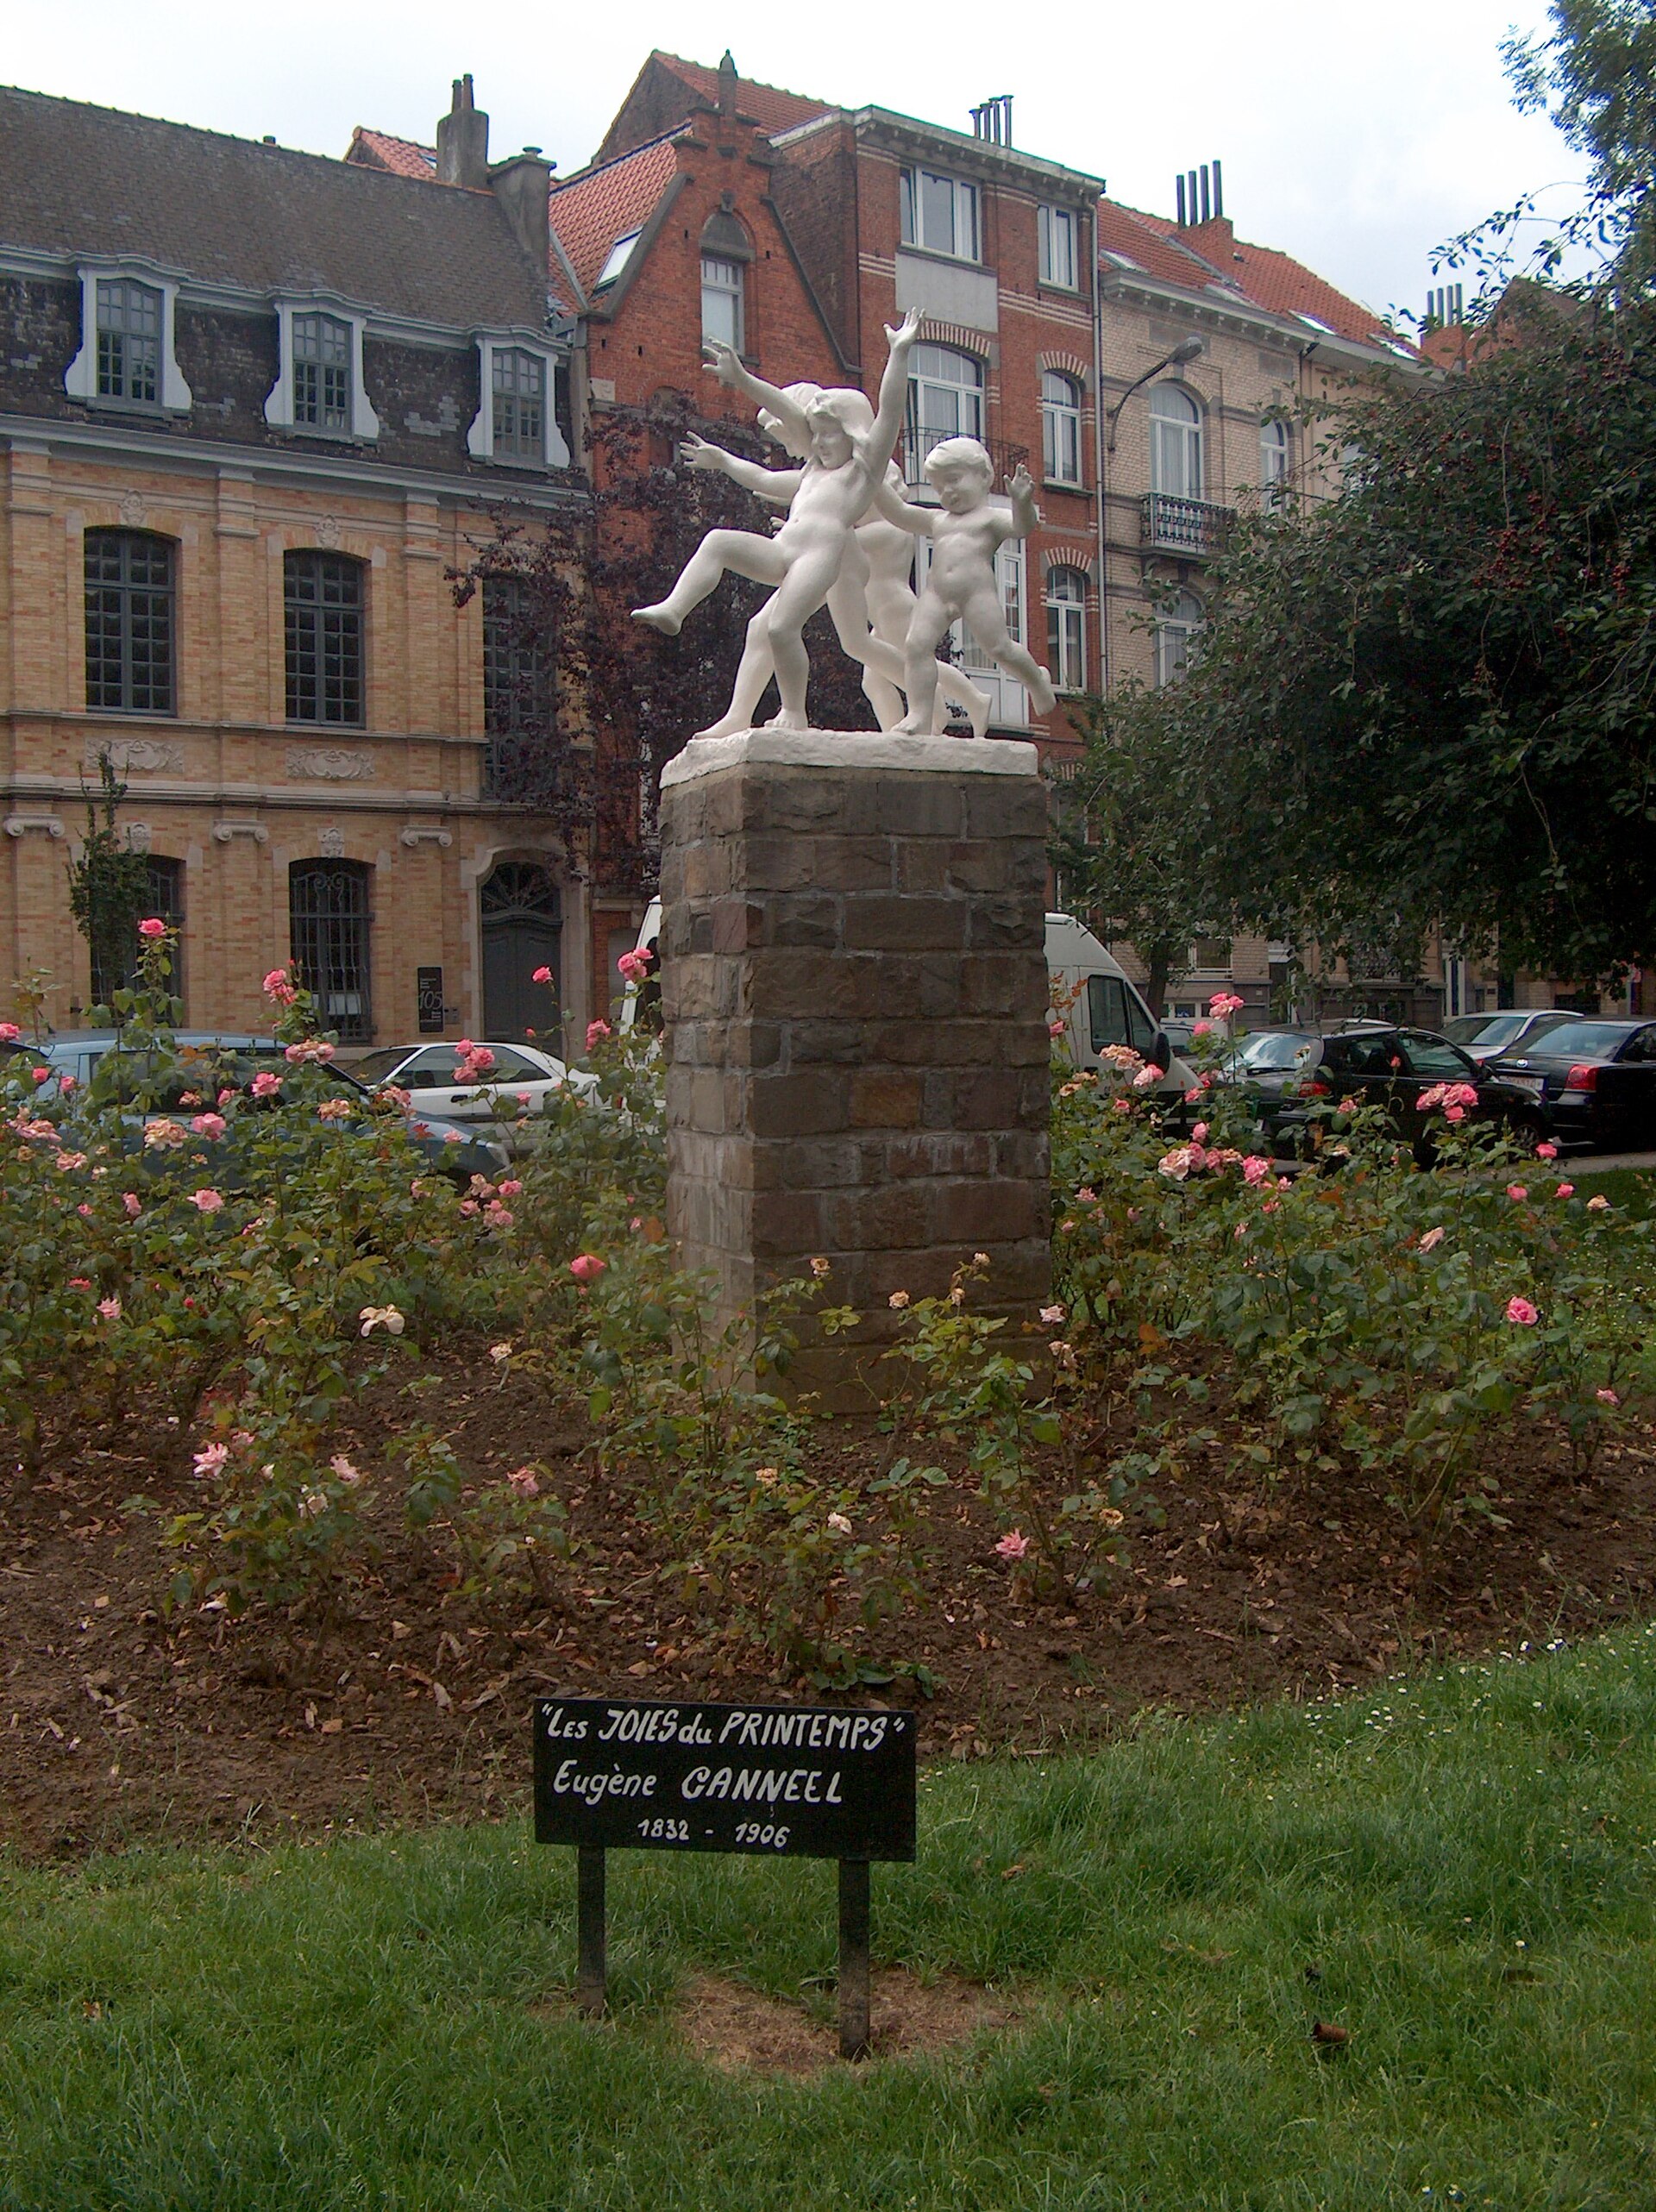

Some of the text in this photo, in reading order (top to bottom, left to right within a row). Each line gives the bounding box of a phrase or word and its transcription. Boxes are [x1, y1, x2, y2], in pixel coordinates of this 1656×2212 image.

[419, 990, 442, 1010] 105
[598, 1708, 680, 1743] JOIES
[678, 1712, 712, 1745] du
[553, 1759, 843, 1806] Eugène CANNEEL
[637, 1818, 690, 1841] 1832
[735, 1822, 791, 1849] 1906
